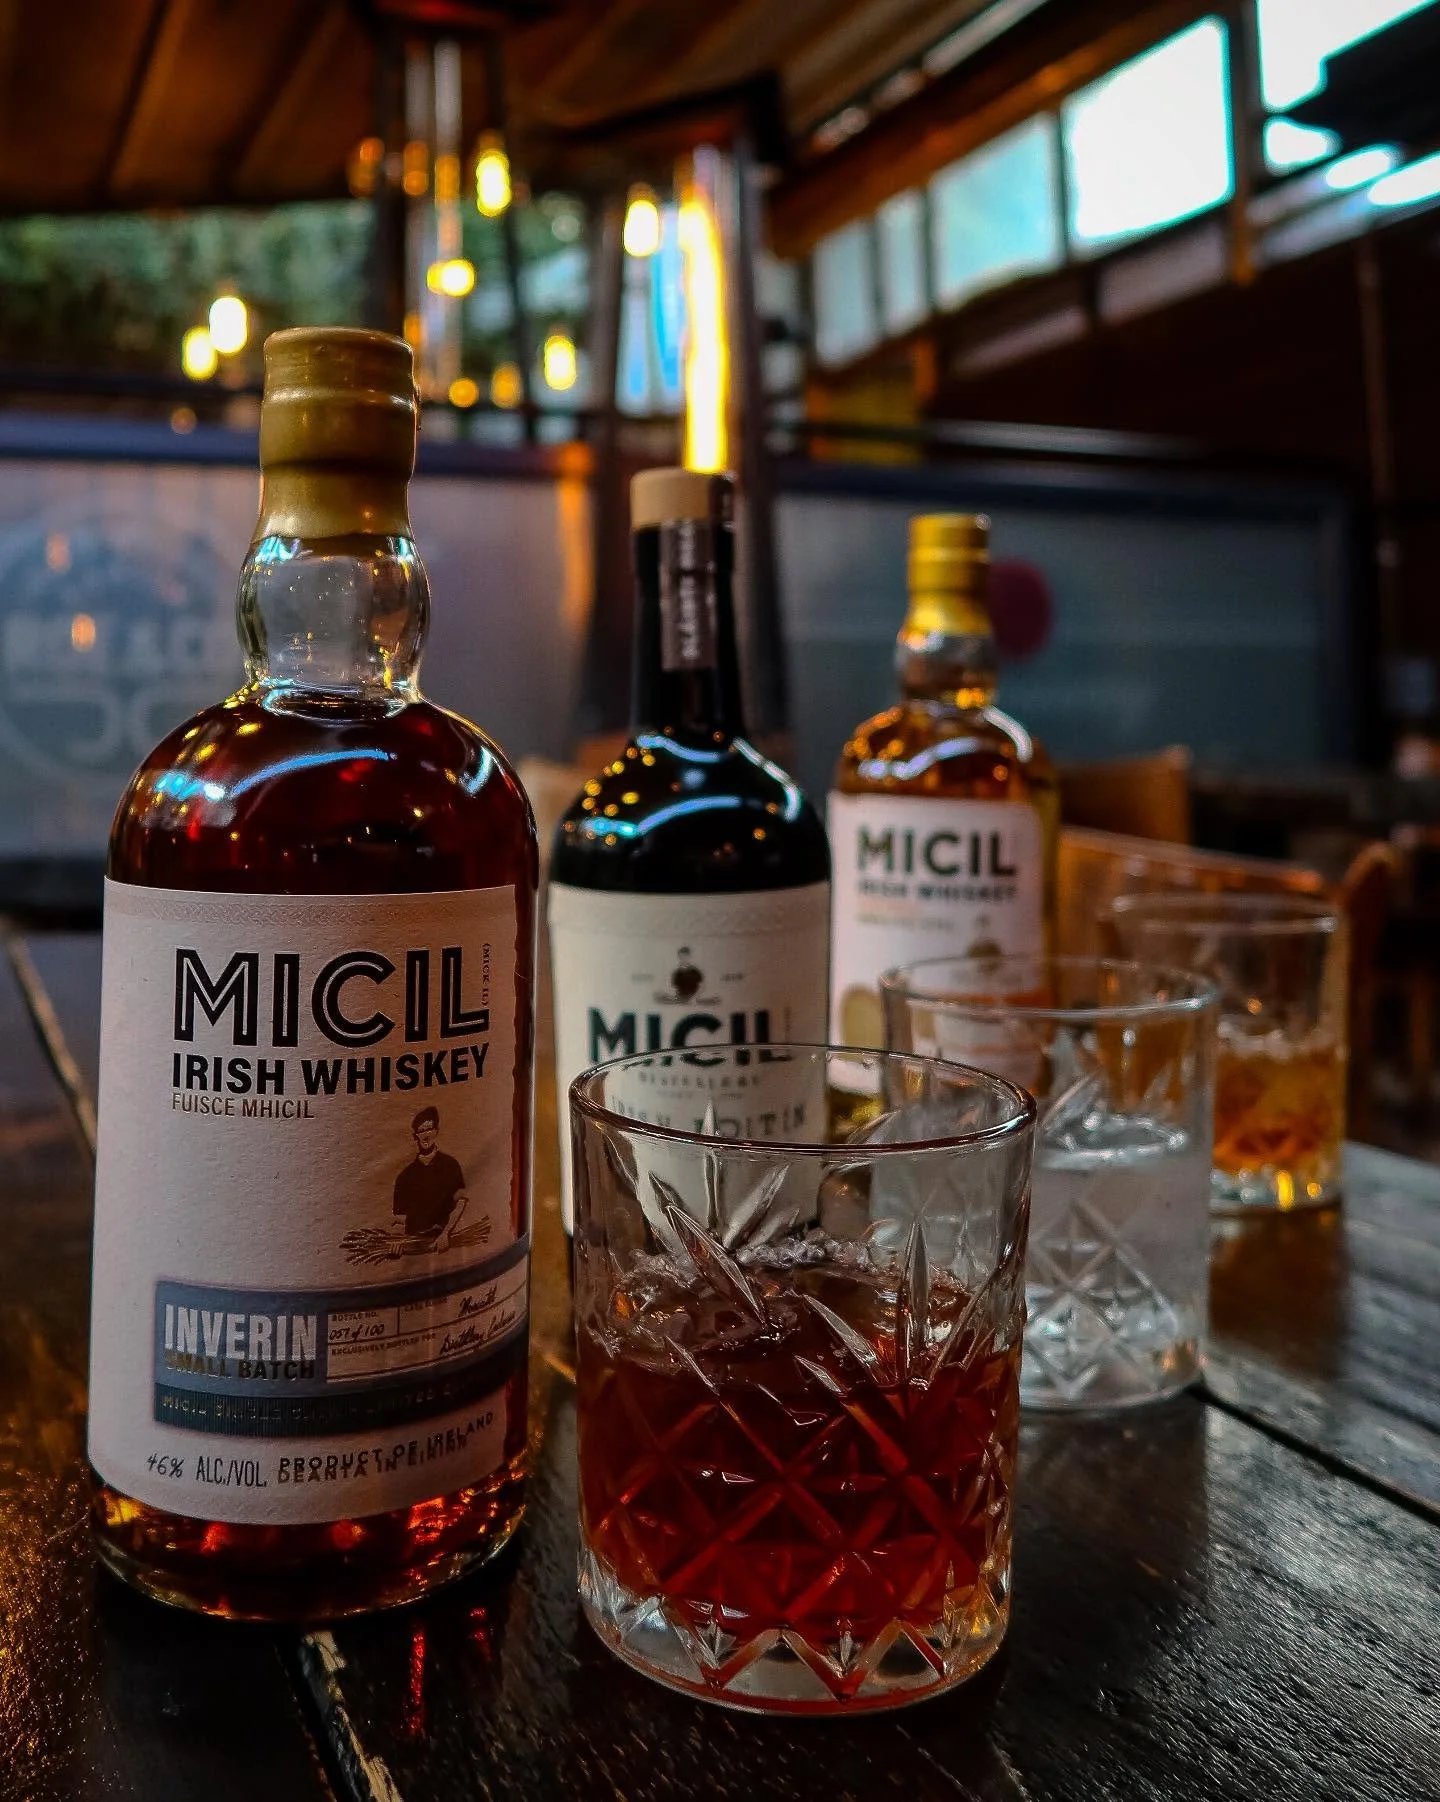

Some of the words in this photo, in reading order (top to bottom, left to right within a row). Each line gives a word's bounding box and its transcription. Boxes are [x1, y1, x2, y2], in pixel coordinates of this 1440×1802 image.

[859, 825, 1017, 877] MICIL
[173, 947, 490, 1048] MICIL
[588, 1006, 793, 1068] MICIL
[172, 1052, 286, 1096] IRISH
[300, 1042, 490, 1096] WHISKEY
[171, 1092, 236, 1118] FUISCE
[241, 1097, 315, 1120] MHICIL
[163, 1303, 317, 1361] INVERIN
[165, 1350, 232, 1379] SMALL
[237, 1356, 316, 1381] BATCH
[146, 1452, 185, 1479] 46%
[279, 1448, 383, 1472] PRODUCT
[427, 1412, 494, 1449] IRELAND
